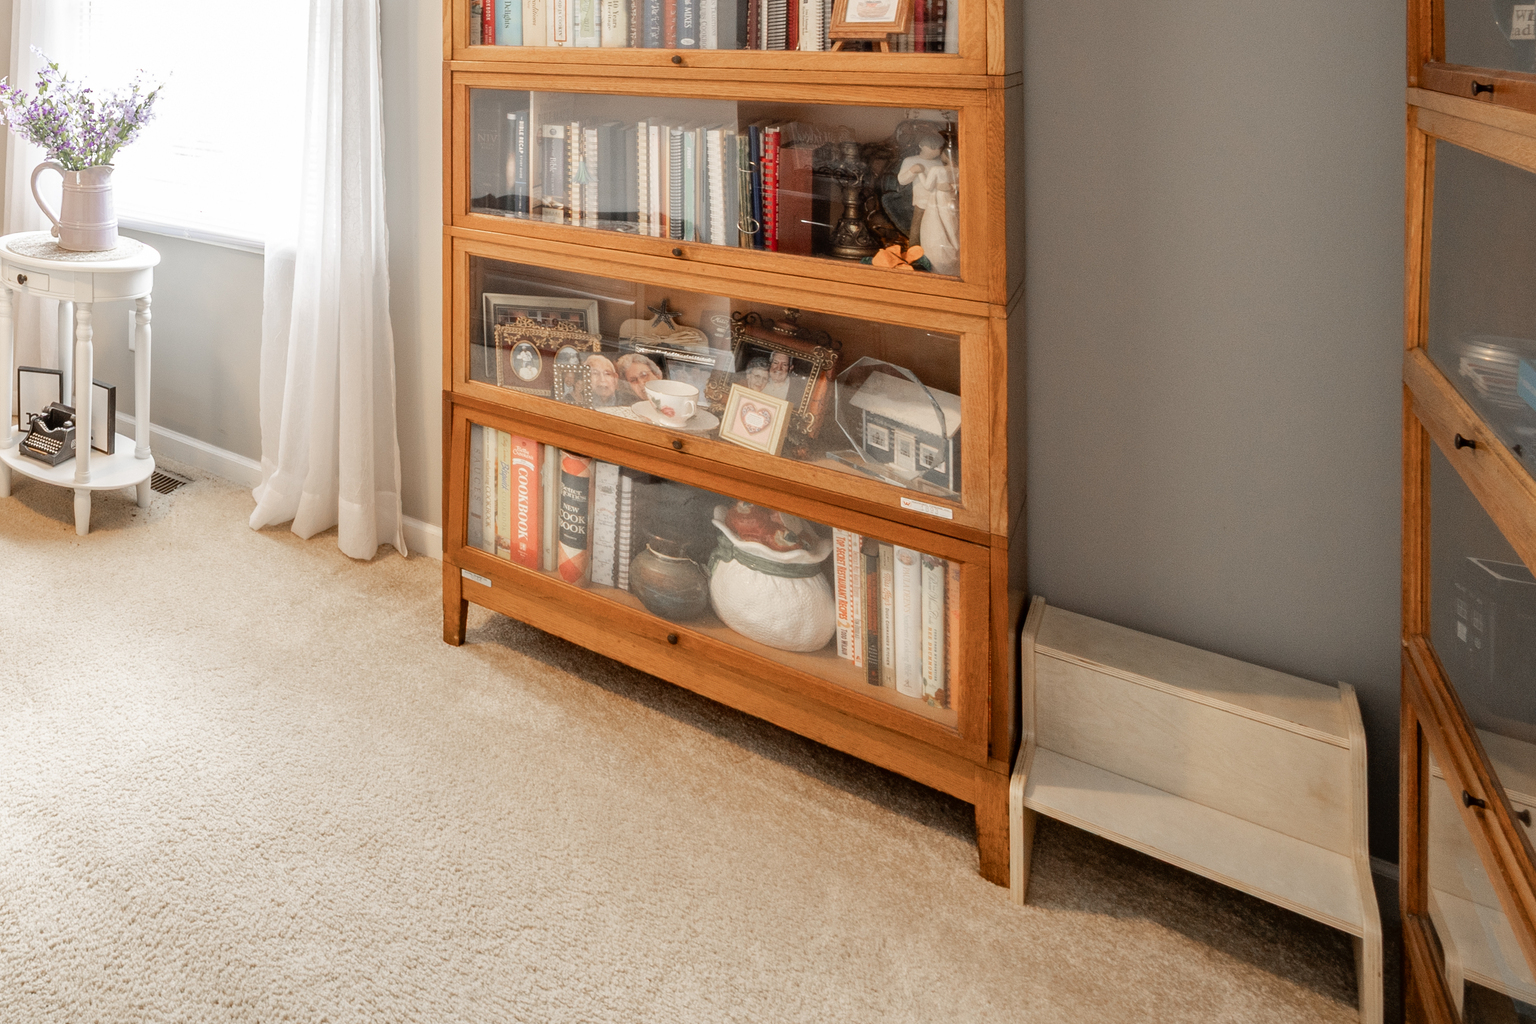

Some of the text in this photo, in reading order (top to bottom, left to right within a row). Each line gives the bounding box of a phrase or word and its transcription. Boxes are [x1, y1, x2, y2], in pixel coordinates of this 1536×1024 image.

[502, 1, 512, 29] Delights
[683, 6, 693, 29] MIXES
[477, 133, 498, 143] NIV
[499, 460, 510, 491] Bisquick
[517, 467, 529, 541] COOKBOOK
[562, 502, 580, 513] NEW
[836, 536, 846, 547] TOP
[836, 547, 847, 566] SECRET
[836, 566, 847, 599] RESTAURANT
[902, 566, 911, 588] PAULA
[838, 599, 849, 621] RECIPES
[837, 620, 850, 629] 2
[841, 640, 849, 656] WILBUR
